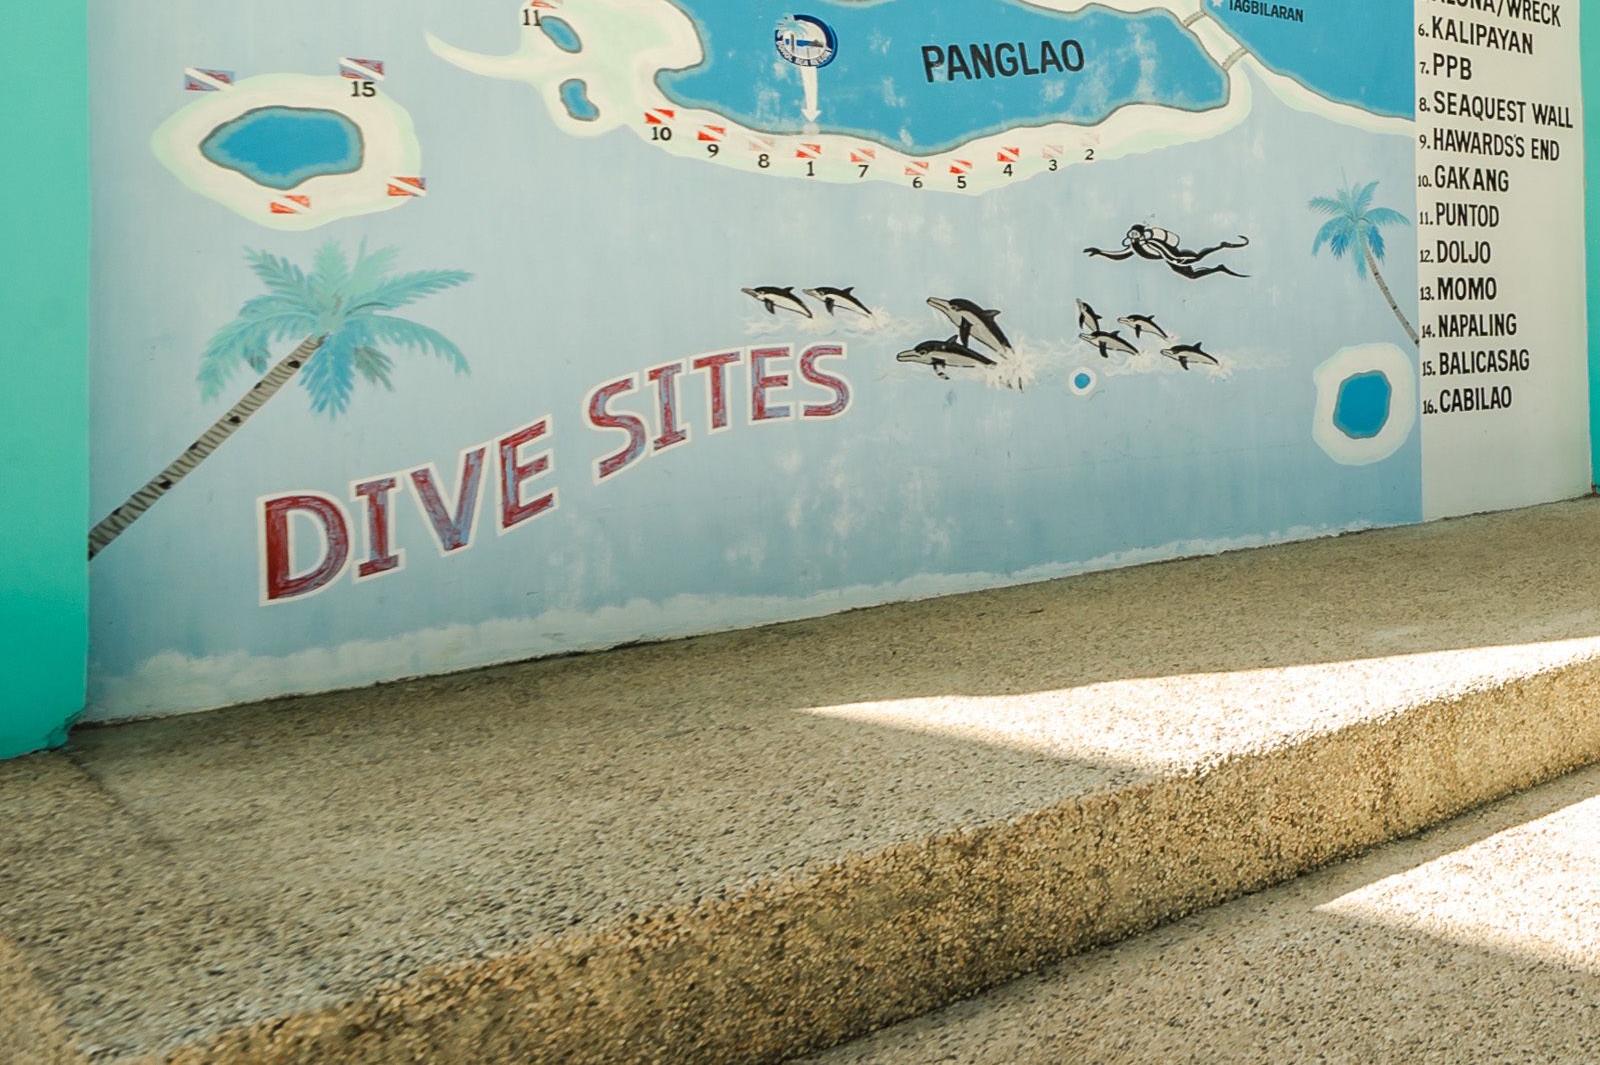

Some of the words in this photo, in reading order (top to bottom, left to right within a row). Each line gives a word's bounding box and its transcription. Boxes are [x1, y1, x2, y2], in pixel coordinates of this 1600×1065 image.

[522, 8, 541, 26] 11
[1417, 23, 1430, 38] 6.
[1432, 15, 1533, 55] KALIPAYAN
[921, 39, 1085, 83] PANGLAO
[1419, 61, 1430, 75] 7.
[1433, 52, 1472, 81] PPB
[351, 80, 376, 98] 15
[1418, 96, 1431, 112] 8.
[1433, 90, 1527, 124] SEAQUEST
[1531, 102, 1574, 129] WALL
[652, 126, 672, 142] 10
[707, 143, 719, 158] 9
[1084, 148, 1095, 161] 2
[1419, 134, 1431, 150] 9.
[1531, 137, 1560, 161] END
[757, 153, 770, 169] 8
[806, 160, 815, 177] 1
[858, 164, 869, 178] 7
[1002, 163, 1013, 177] 4
[1048, 159, 1058, 172] 3
[912, 176, 923, 189] 6
[957, 175, 967, 189] 5
[1417, 174, 1433, 188] 10.
[1434, 164, 1509, 193] GAKANG
[1419, 211, 1434, 226] 11.
[1435, 202, 1500, 228] PUNTOD
[1419, 249, 1435, 264] 12.
[1436, 239, 1491, 264] DOLJO
[1420, 286, 1435, 301] 13.
[1437, 276, 1497, 301] MOMO
[1421, 324, 1436, 339] 14.
[1438, 313, 1517, 338] NAPALING
[1422, 360, 1437, 377] 15.
[1439, 348, 1530, 376] BALICASAG
[1422, 399, 1438, 415] 16.
[1439, 385, 1512, 413] CABILAO
[259, 416, 557, 603] DIVE
[585, 342, 852, 483] SITES
